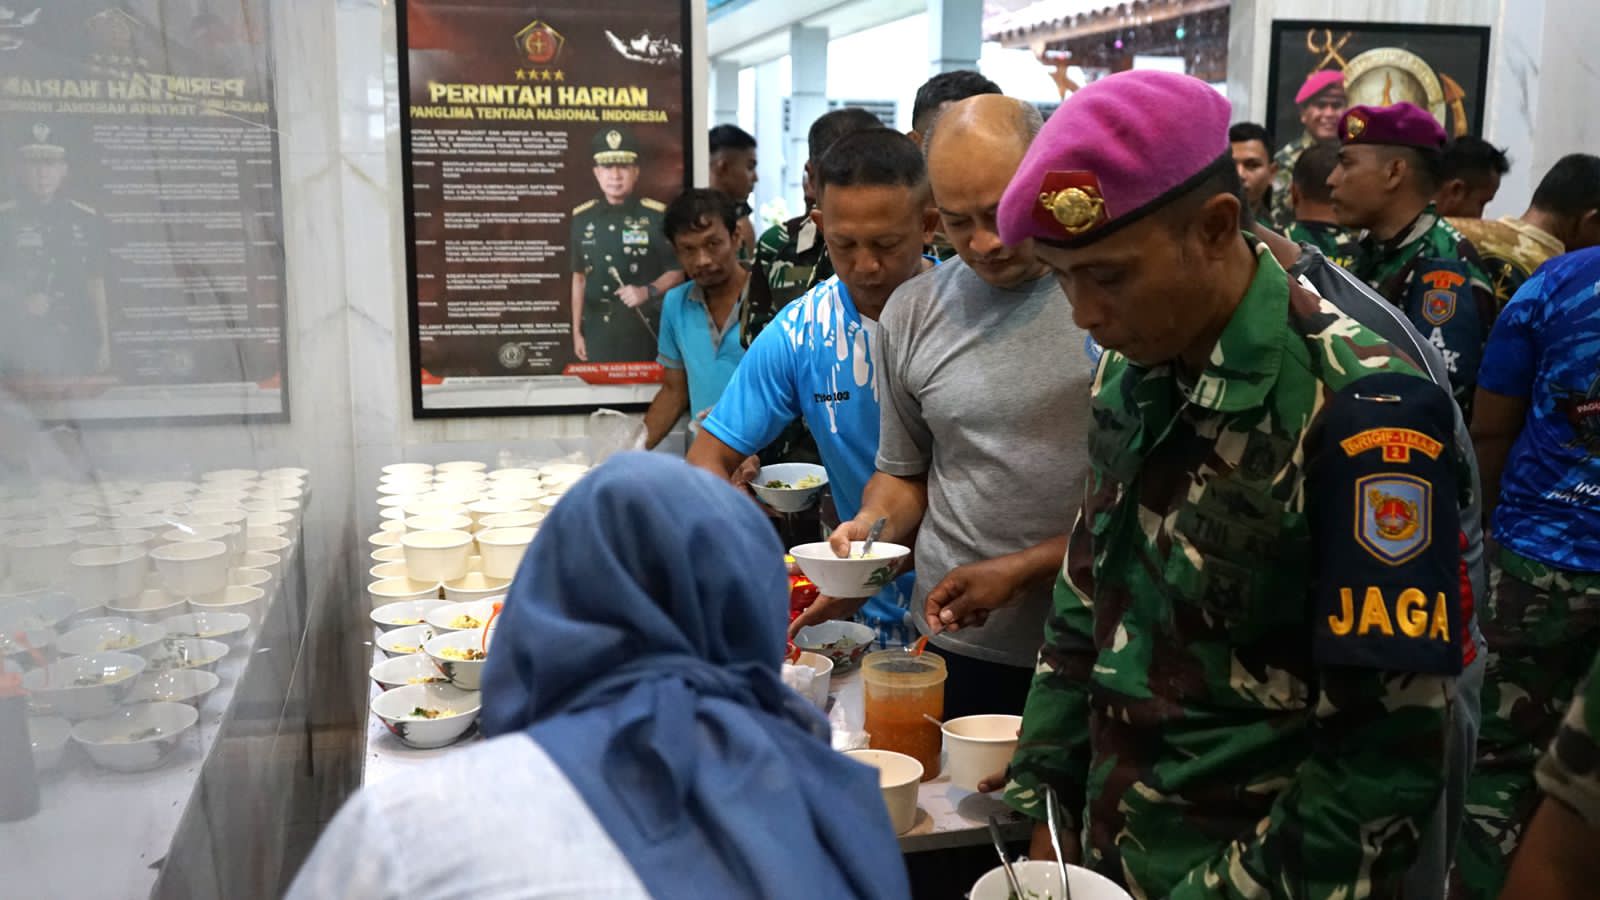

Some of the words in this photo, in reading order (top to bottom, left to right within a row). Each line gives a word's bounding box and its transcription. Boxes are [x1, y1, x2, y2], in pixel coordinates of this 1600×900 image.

[429, 83, 551, 106] PERINTAH
[557, 85, 649, 107] HARIAN
[410, 105, 474, 120] PANGLIMA
[478, 107, 534, 121] TENTARA
[537, 108, 600, 121] NASIONAL
[602, 108, 669, 122] INDONESIA
[1328, 586, 1450, 642] JAGA
